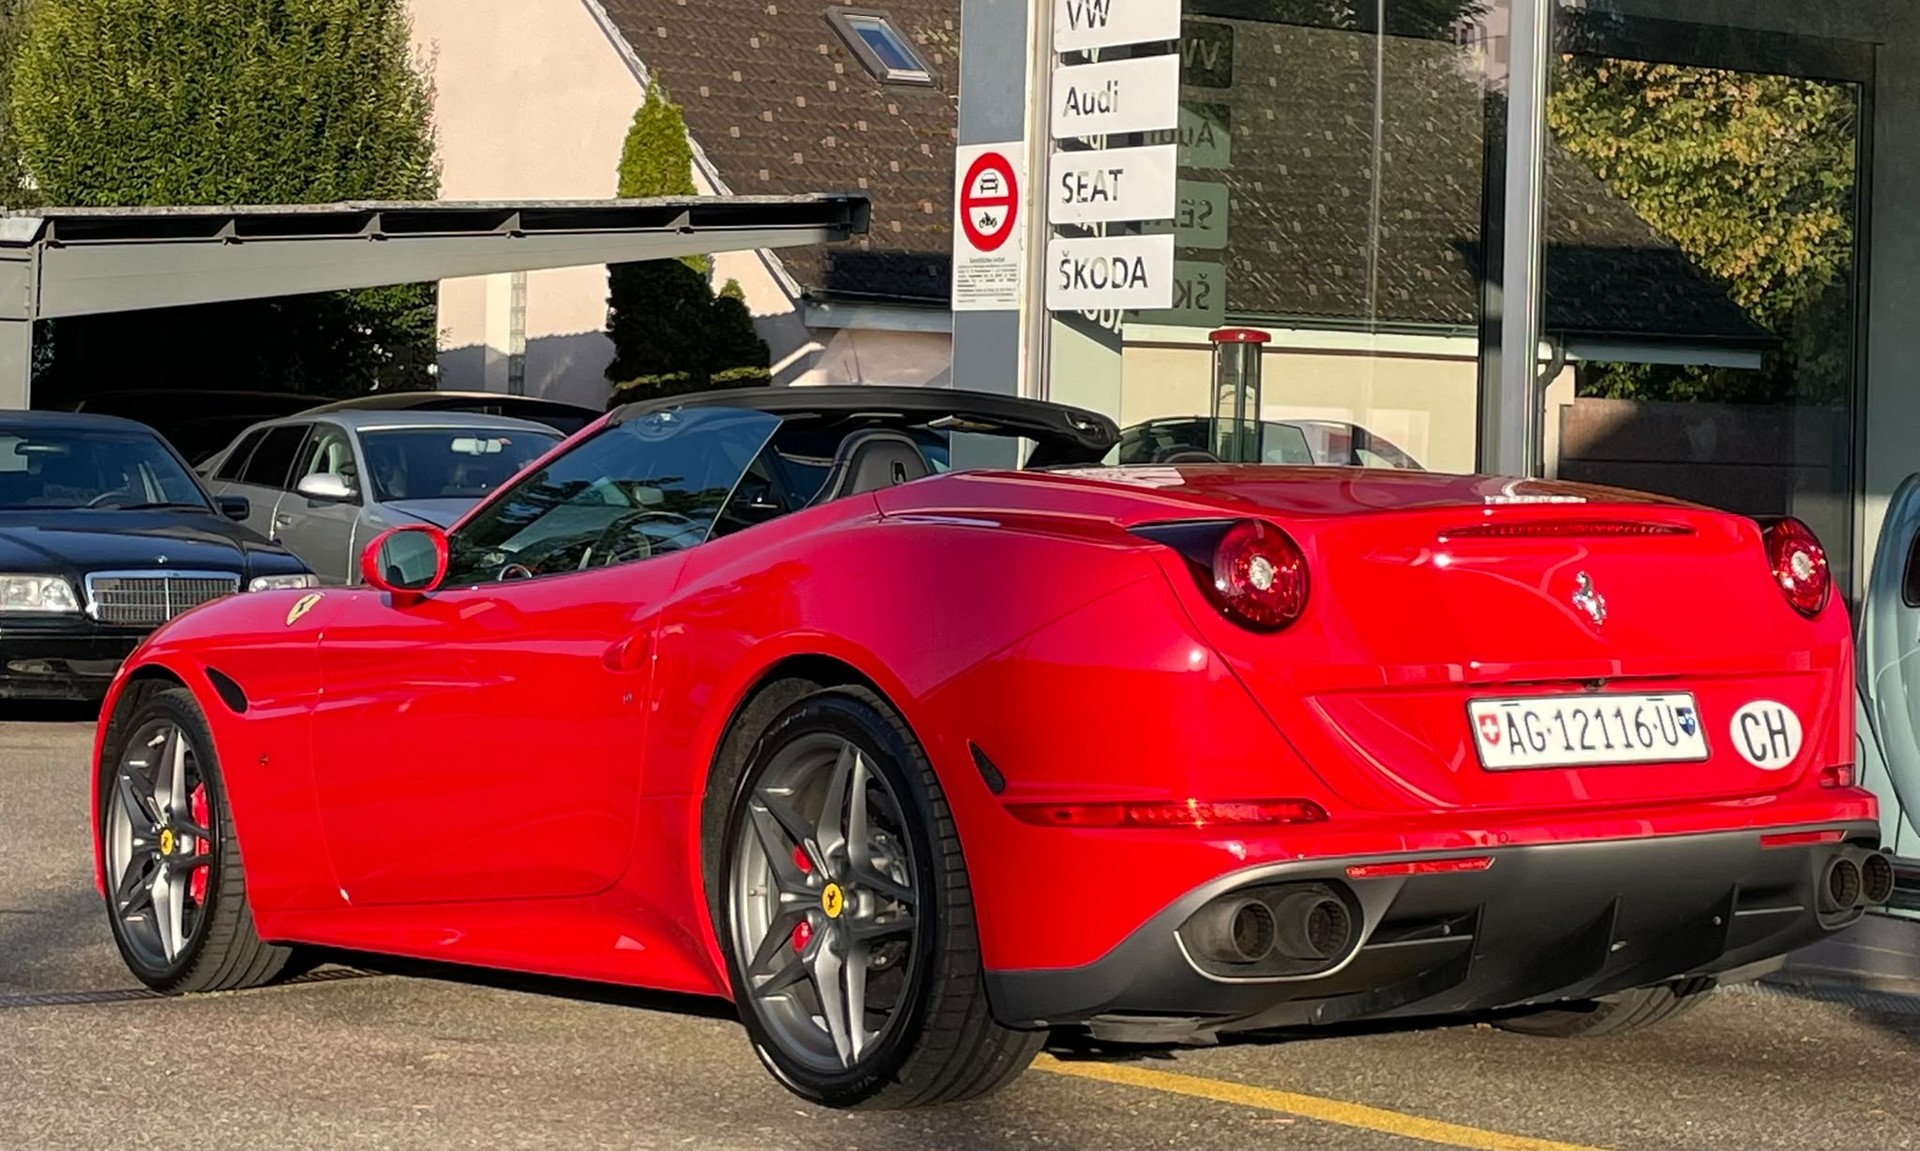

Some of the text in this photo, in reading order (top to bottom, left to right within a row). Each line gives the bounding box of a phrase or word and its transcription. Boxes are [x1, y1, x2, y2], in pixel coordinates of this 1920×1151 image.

[1066, 0, 1110, 31] VW
[1063, 80, 1119, 117] Audi
[1061, 168, 1124, 204] SEAT
[1058, 249, 1149, 291] ŠKODA
[1740, 709, 1791, 762] CH
